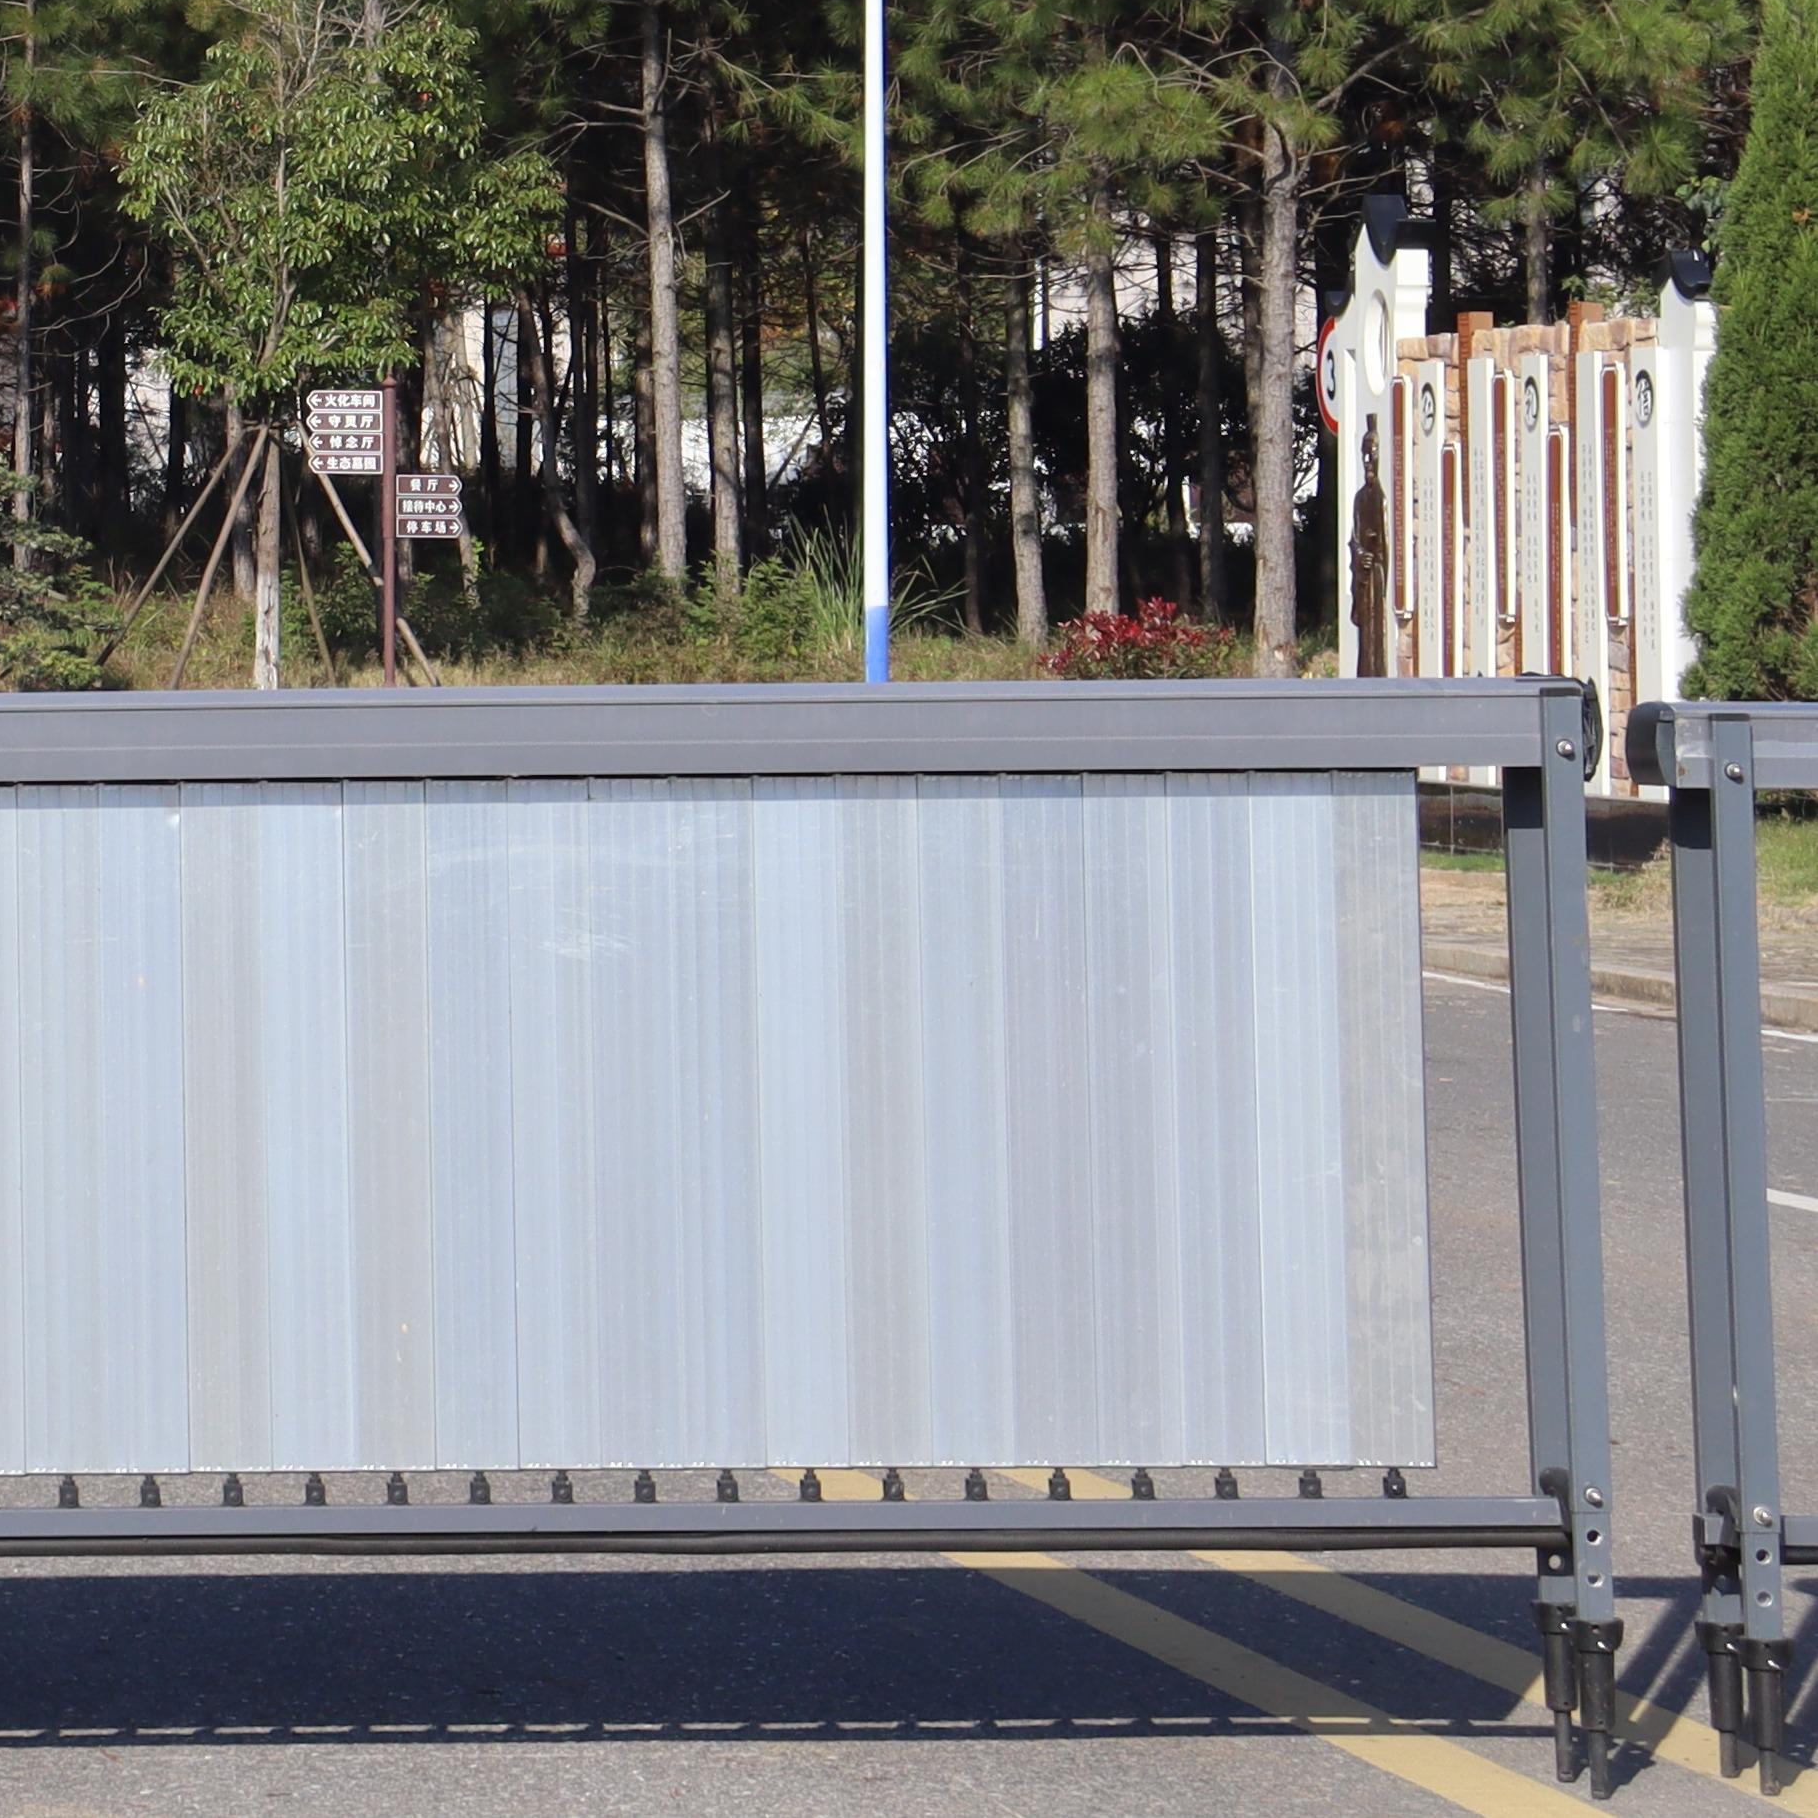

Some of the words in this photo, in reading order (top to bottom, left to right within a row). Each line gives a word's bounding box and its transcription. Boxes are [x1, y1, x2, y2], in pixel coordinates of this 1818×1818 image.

[324, 393, 376, 408] 火化车间
[329, 435, 374, 449] 悼念厅
[410, 478, 439, 492] 餐厅
[402, 499, 447, 513] 接待中心
[406, 520, 447, 534] 停车场
